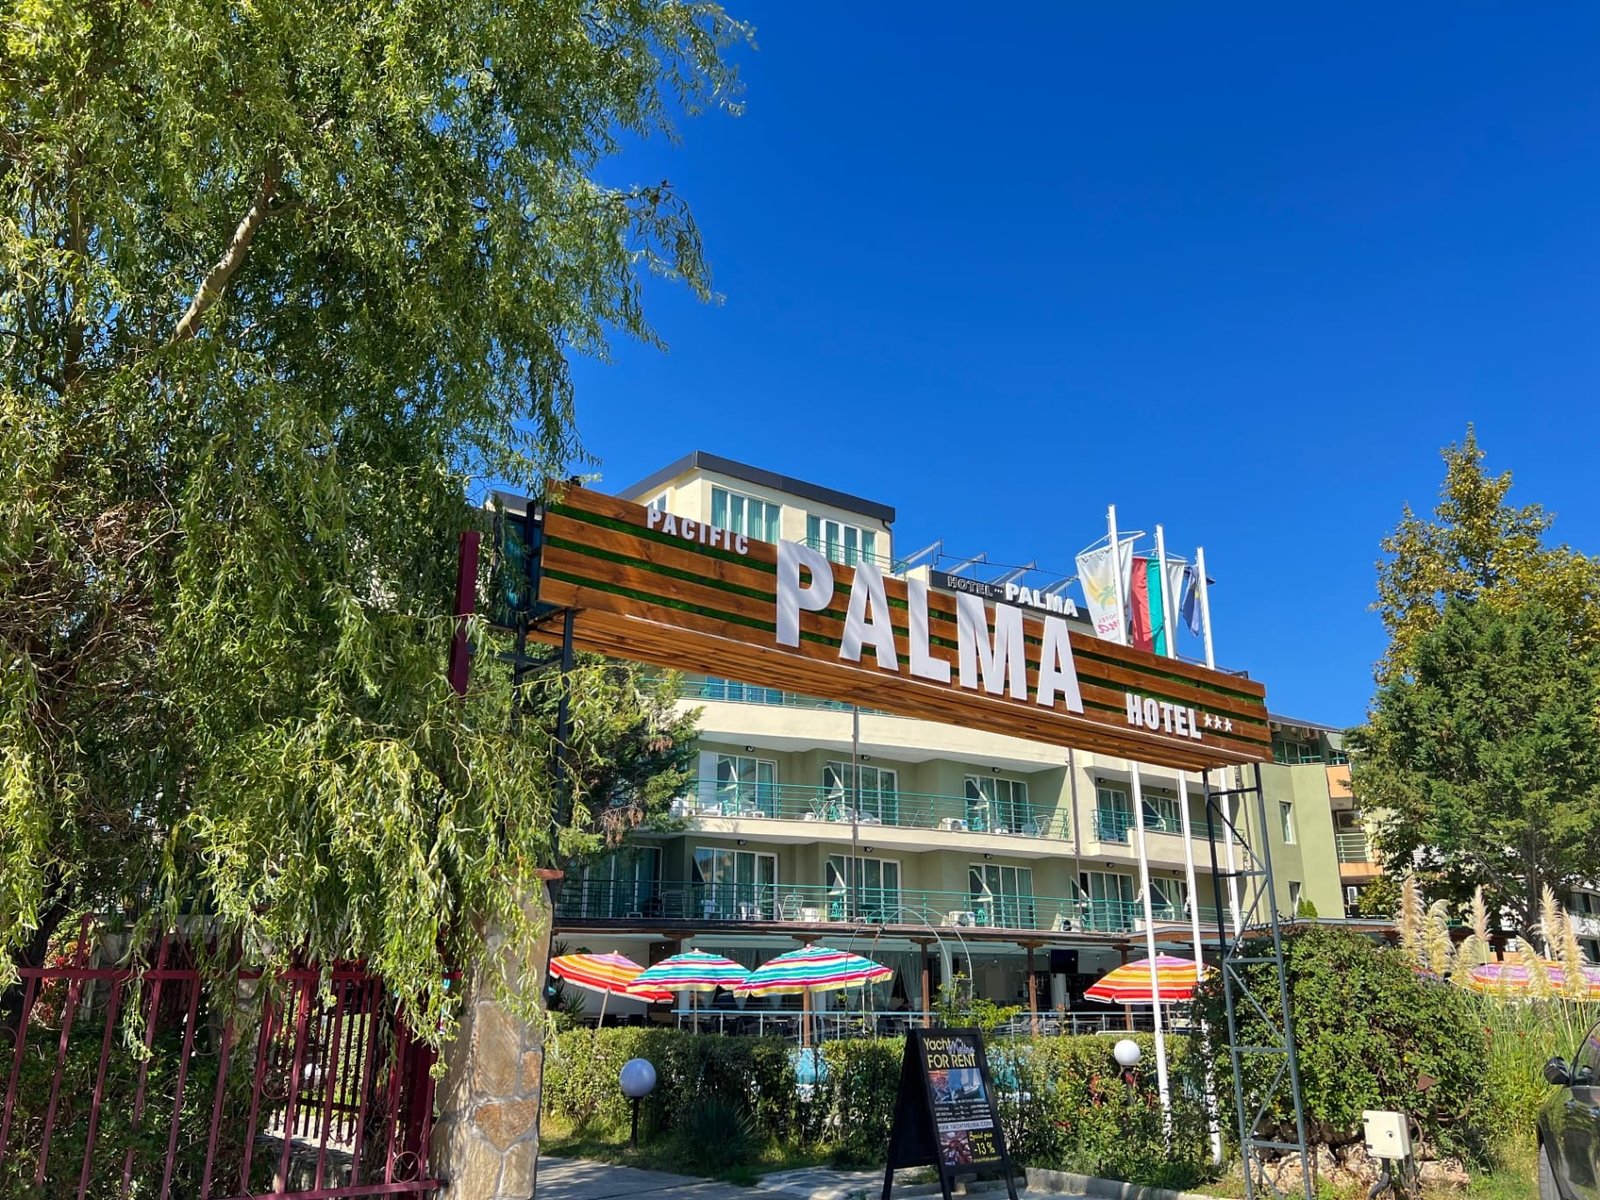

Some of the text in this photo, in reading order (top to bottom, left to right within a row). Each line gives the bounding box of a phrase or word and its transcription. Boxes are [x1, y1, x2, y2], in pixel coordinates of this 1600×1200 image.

[647, 506, 748, 555] PACIFIC
[947, 575, 1079, 617] HOTEL PALMA
[776, 539, 1084, 714] PALMA
[1125, 692, 1202, 740] HOTEL
[927, 1054, 976, 1069] FOR RENT
